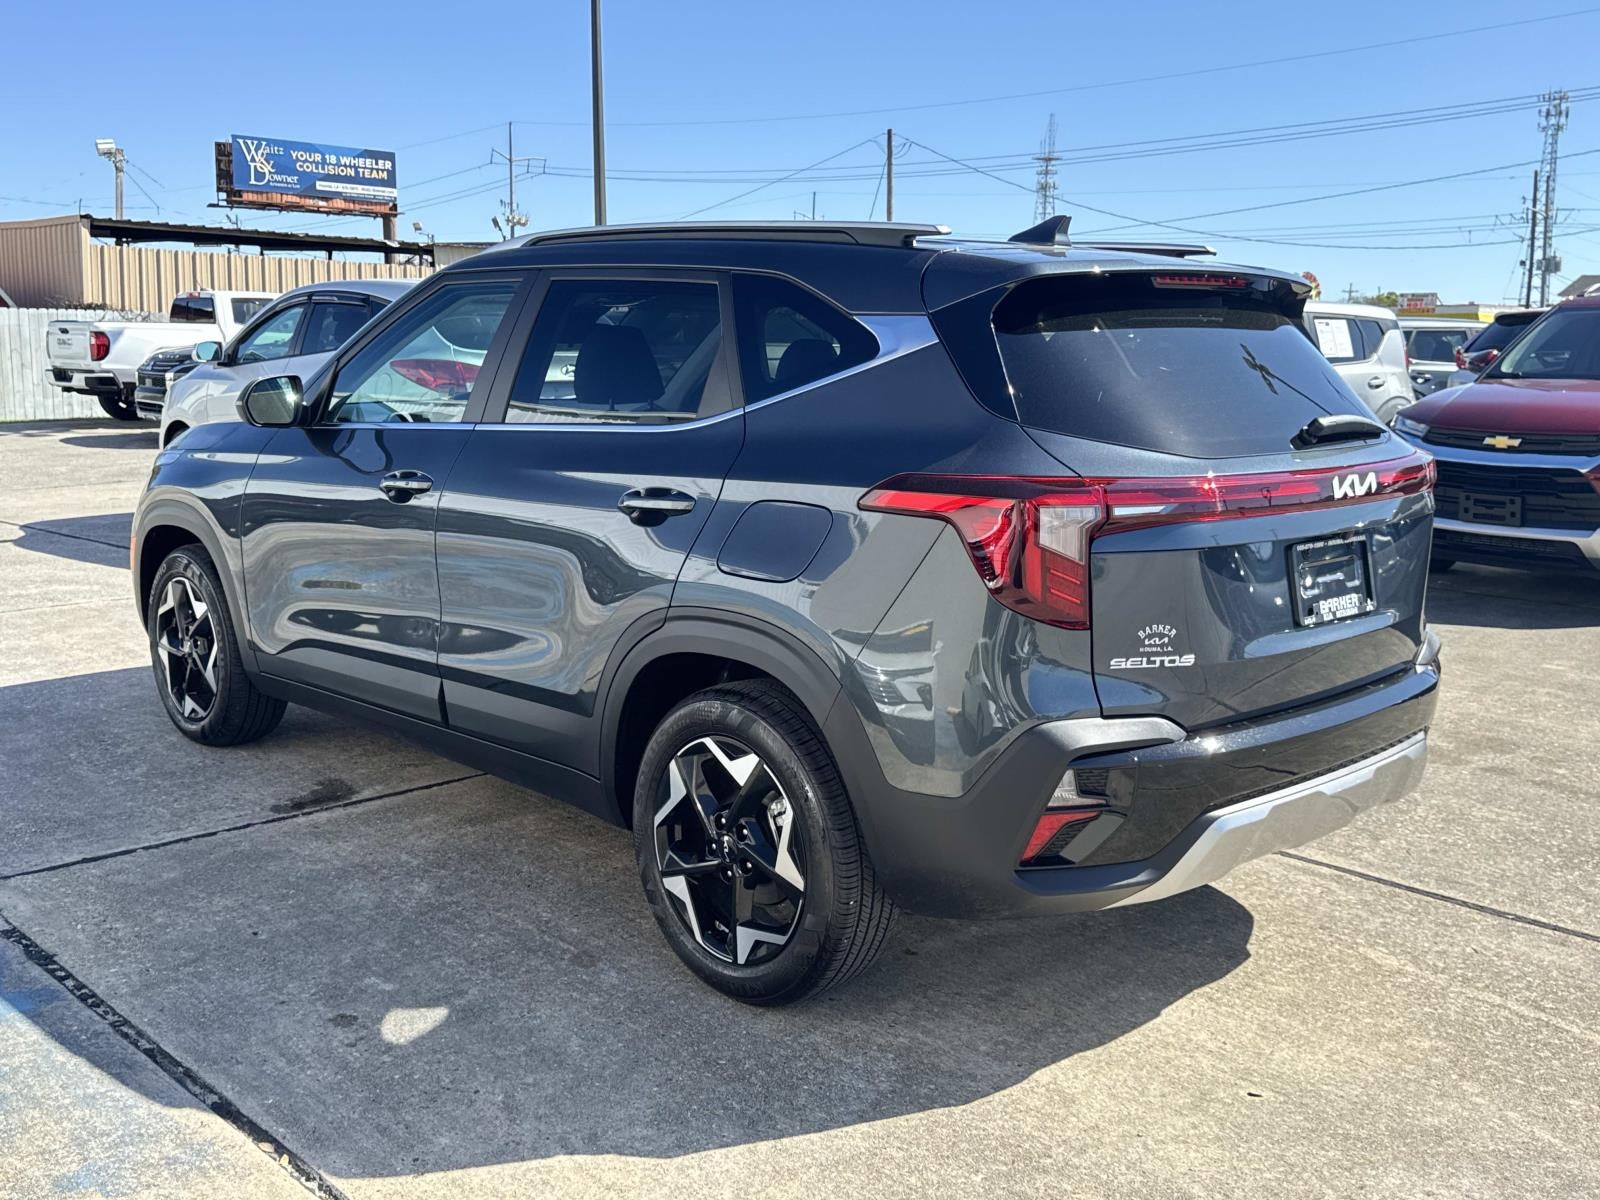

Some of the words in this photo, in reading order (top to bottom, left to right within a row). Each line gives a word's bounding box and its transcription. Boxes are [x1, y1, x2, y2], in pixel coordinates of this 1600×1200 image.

[236, 138, 284, 163] Waitz
[290, 150, 322, 163] YOUR
[325, 153, 337, 164] 18
[339, 155, 392, 171] WHEELER
[248, 161, 299, 186] Downer
[296, 161, 355, 177] COLLISION
[358, 168, 388, 180] TEAM
[1332, 472, 1377, 499] KIA
[1319, 592, 1360, 614] BARKER
[1137, 624, 1177, 639] BARKER
[1109, 653, 1196, 669] SELTOS
